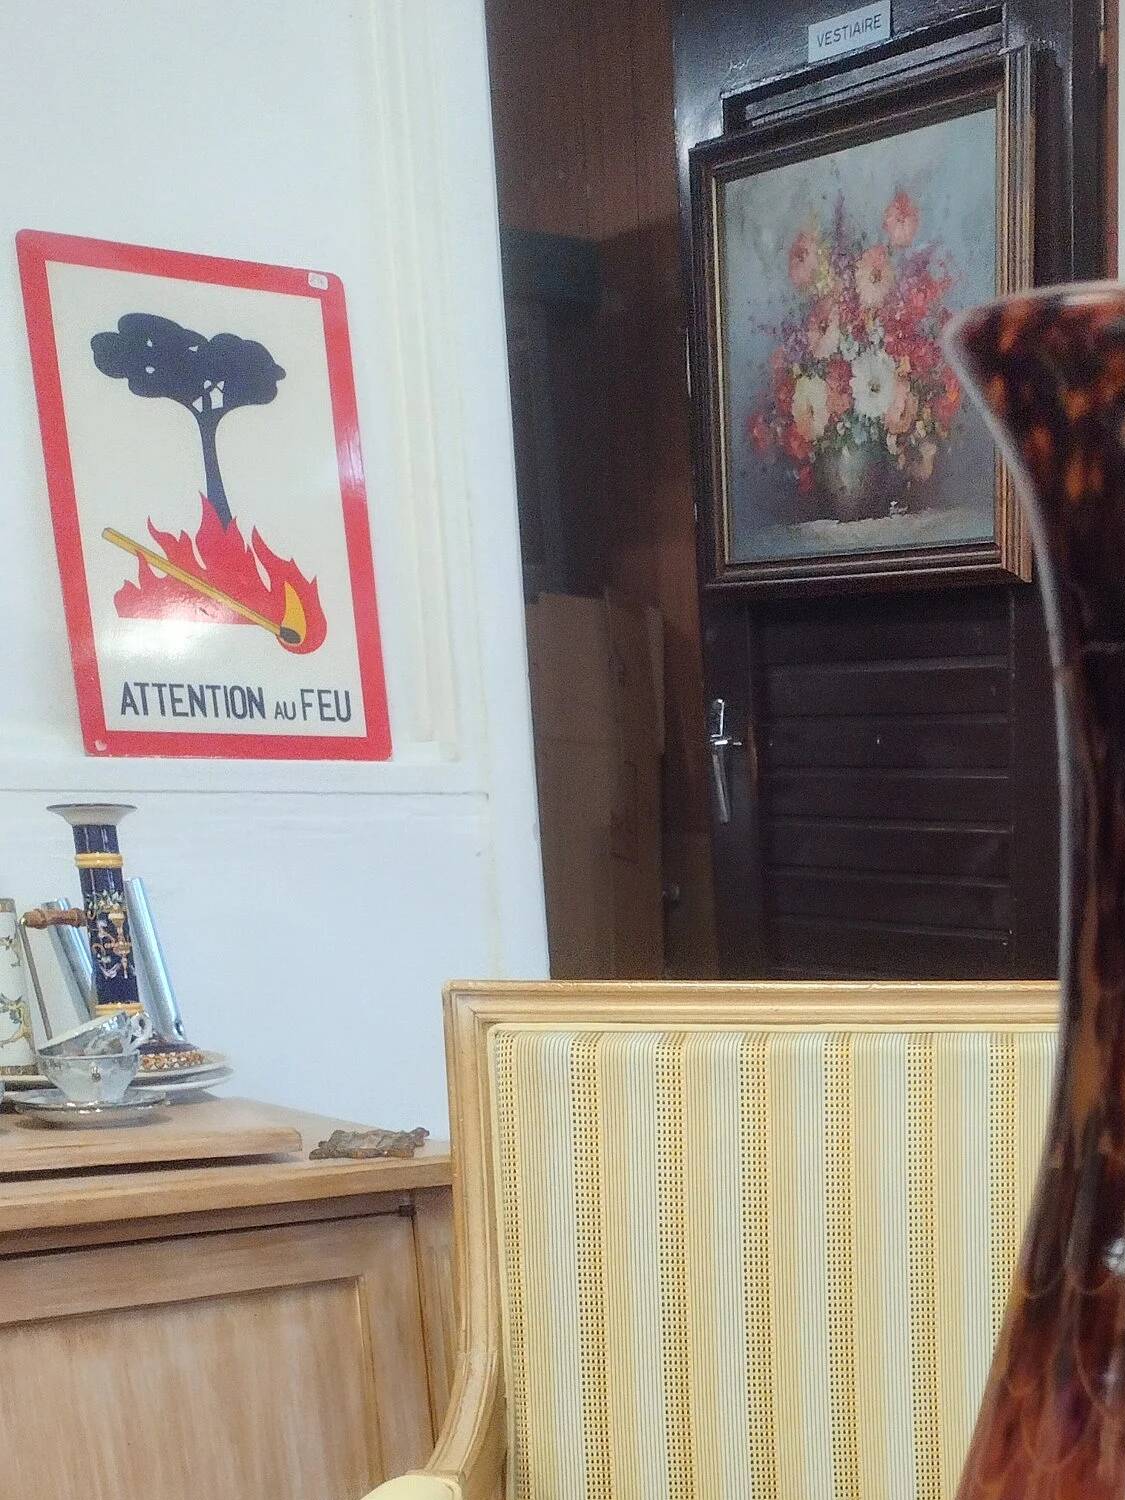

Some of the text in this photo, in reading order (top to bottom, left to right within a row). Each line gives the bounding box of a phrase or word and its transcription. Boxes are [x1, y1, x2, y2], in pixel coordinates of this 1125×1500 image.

[816, 13, 882, 48] VESTIAIRE
[120, 681, 352, 723] ATTENTION AU FEU
